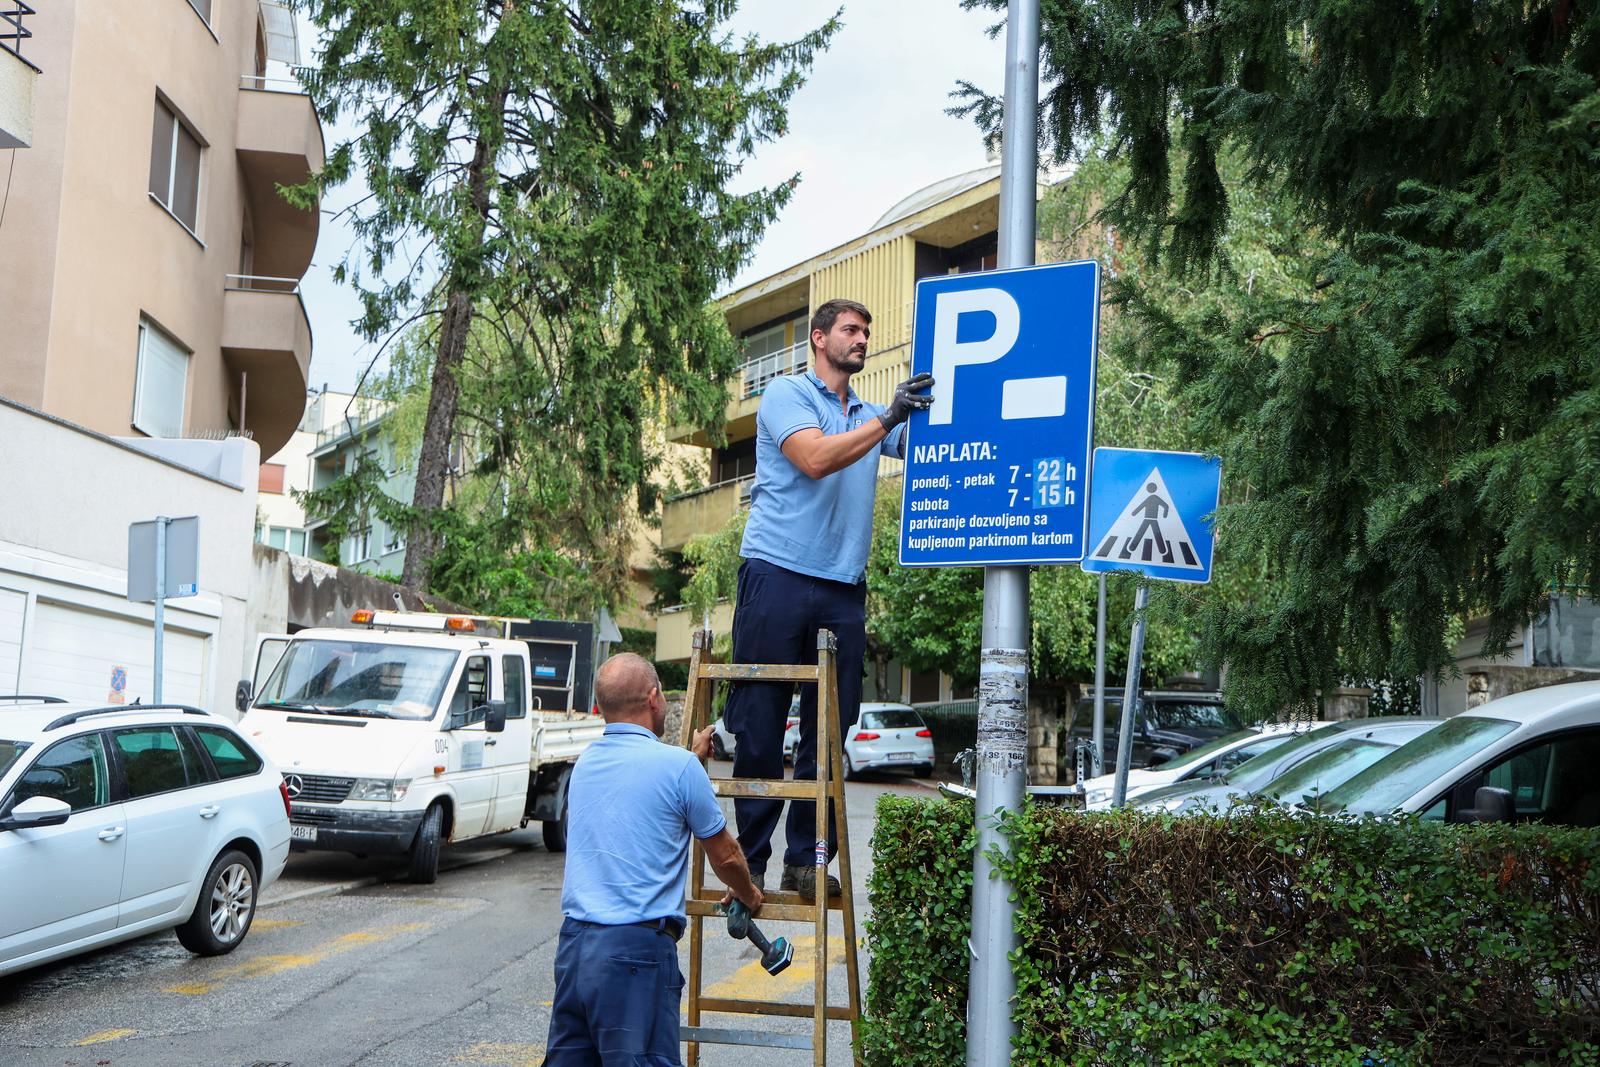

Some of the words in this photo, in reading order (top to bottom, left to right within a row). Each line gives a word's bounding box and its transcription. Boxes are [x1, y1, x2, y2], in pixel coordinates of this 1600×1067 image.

[929, 287, 1021, 426] P
[913, 441, 998, 464] NAPLATA:
[912, 475, 952, 491] ponedj.
[964, 473, 995, 489] petak
[1009, 465, 1020, 484] 7
[1037, 459, 1060, 482] 22
[1065, 462, 1076, 481] h
[911, 498, 949, 512] subota
[1008, 488, 1019, 507] 7
[1038, 484, 1060, 506] 15
[1064, 486, 1075, 505] h
[909, 516, 966, 532] parkiranje
[969, 513, 1030, 529] dozvoljeno
[1033, 514, 1048, 526] sa
[908, 536, 966, 551] kupljenom
[969, 533, 1028, 550] parkirnom
[1031, 532, 1073, 545] kartom
